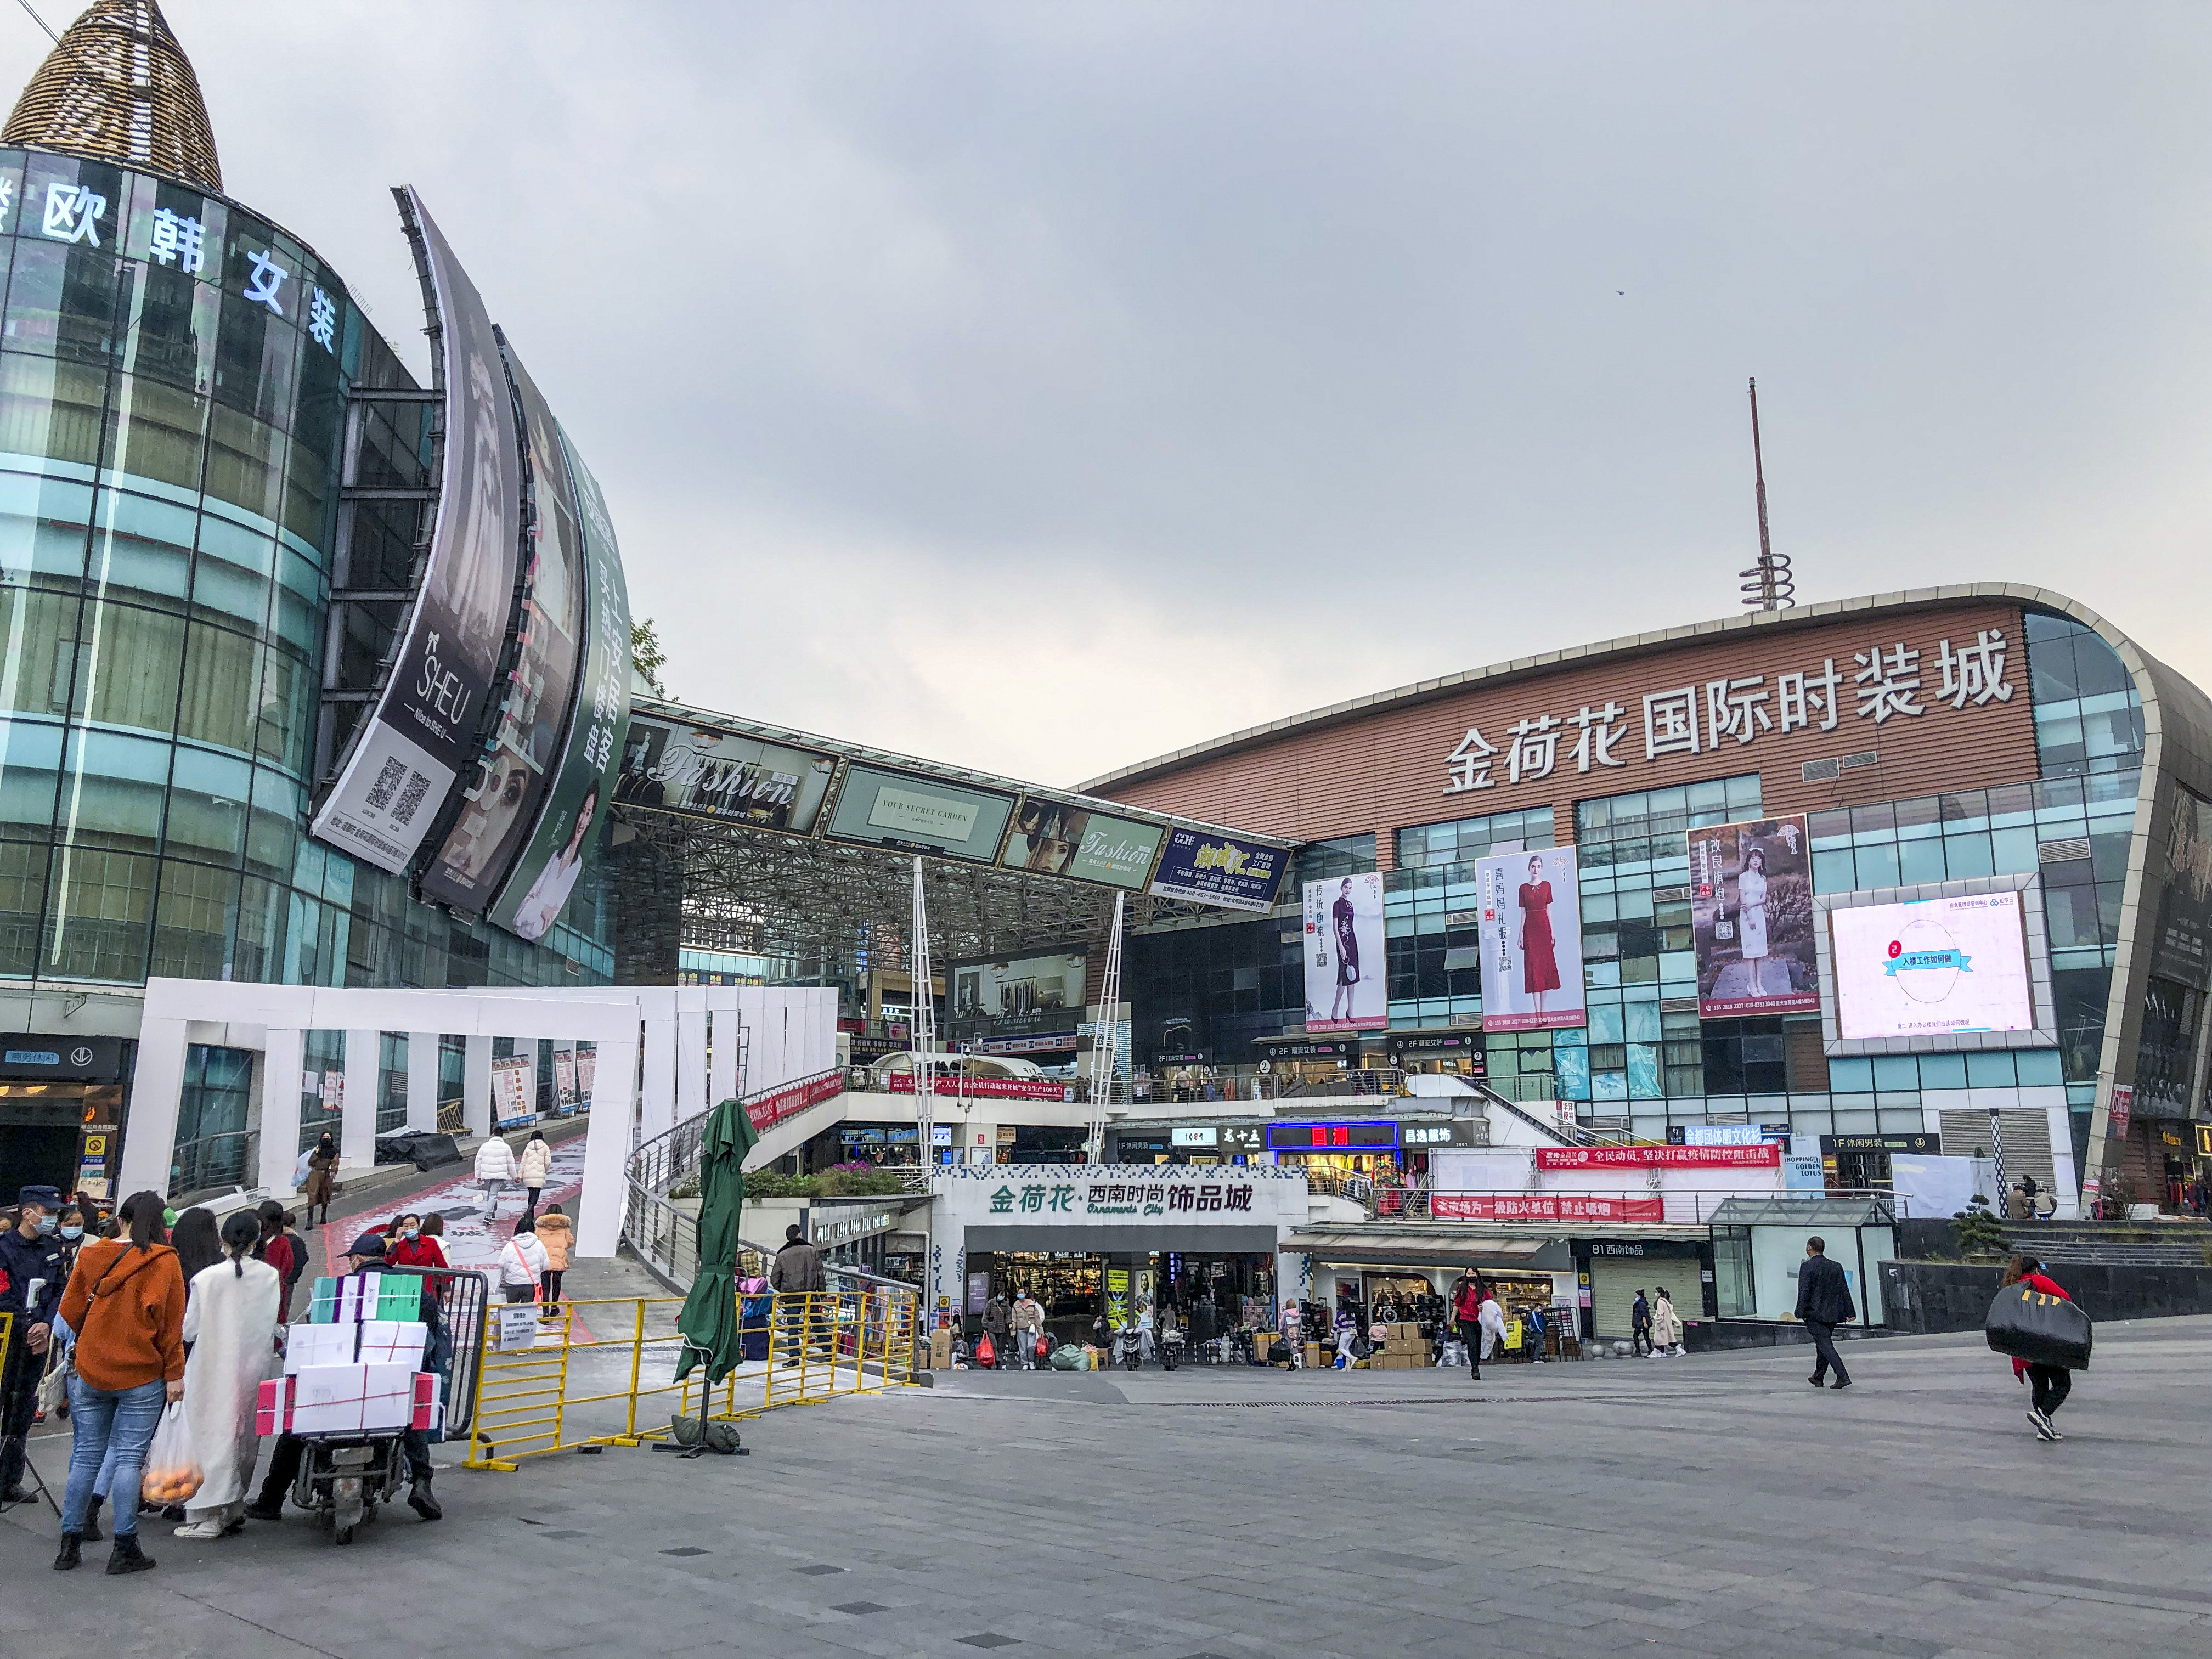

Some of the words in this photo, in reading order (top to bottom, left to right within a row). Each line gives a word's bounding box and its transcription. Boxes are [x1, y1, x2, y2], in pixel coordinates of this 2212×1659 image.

[0, 176, 335, 354] 欧韩女装
[416, 656, 471, 725] SHEU
[1442, 628, 2013, 795] 金荷花国际时装城
[646, 744, 794, 805] Fashion
[883, 799, 904, 810] YOUR
[906, 804, 936, 816] SECRET
[938, 810, 968, 822] GARDEN
[1079, 831, 1148, 865] Fashion
[1711, 838, 1725, 901] 改良旗袍
[1316, 884, 1325, 937] 传统旗袍
[1495, 867, 1506, 940] 喜妈妈礼服
[1903, 955, 1952, 966] 入楼工作如何做
[1311, 1127, 1349, 1146] 国潮
[1405, 1128, 1452, 1143] 昌逸服饰
[1686, 1127, 1762, 1145] 金都团体服文化衫
[1833, 1139, 1844, 1148] 1F
[1847, 1138, 1883, 1148] 休闲男装
[1087, 1203, 1137, 1214] Ornaments
[1143, 1203, 1164, 1216] City
[1088, 1184, 1164, 1203] 西南时尚
[1167, 1184, 1253, 1212] 饰品城
[1437, 1201, 1555, 1215] 本市场为一级防火单位
[1561, 1201, 1610, 1216] 禁止吸烟
